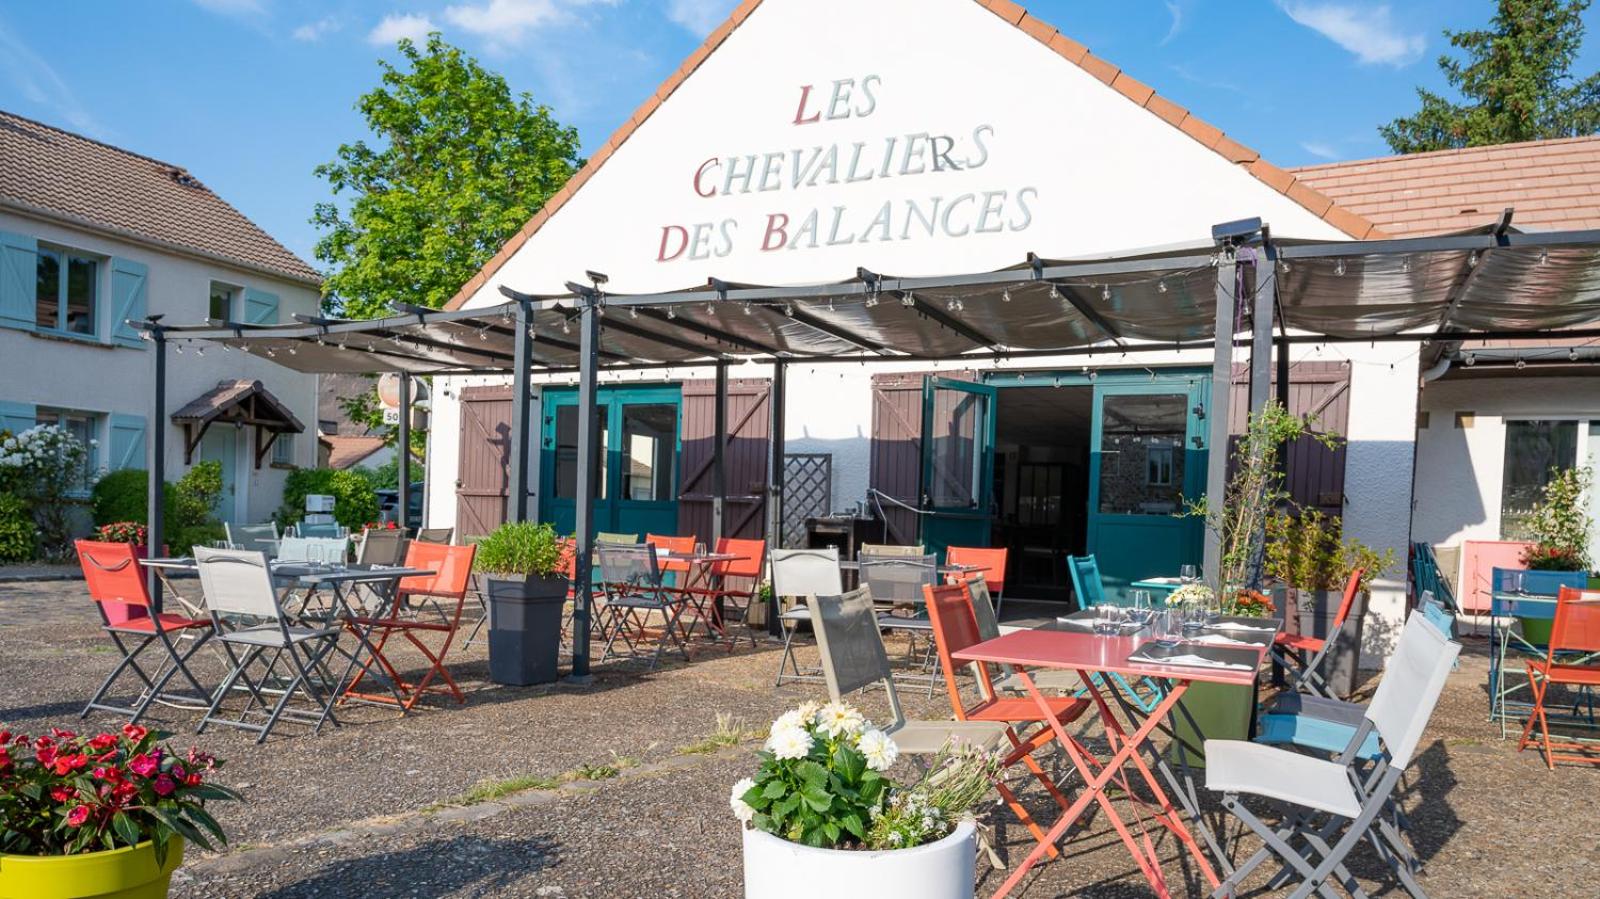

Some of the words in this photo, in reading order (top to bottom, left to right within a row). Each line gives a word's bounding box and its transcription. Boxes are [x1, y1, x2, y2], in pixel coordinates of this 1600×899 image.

[793, 75, 881, 125] LES
[693, 125, 994, 197] CHEVALIERS
[656, 218, 738, 262] DES
[760, 187, 1039, 251] BALANCES
